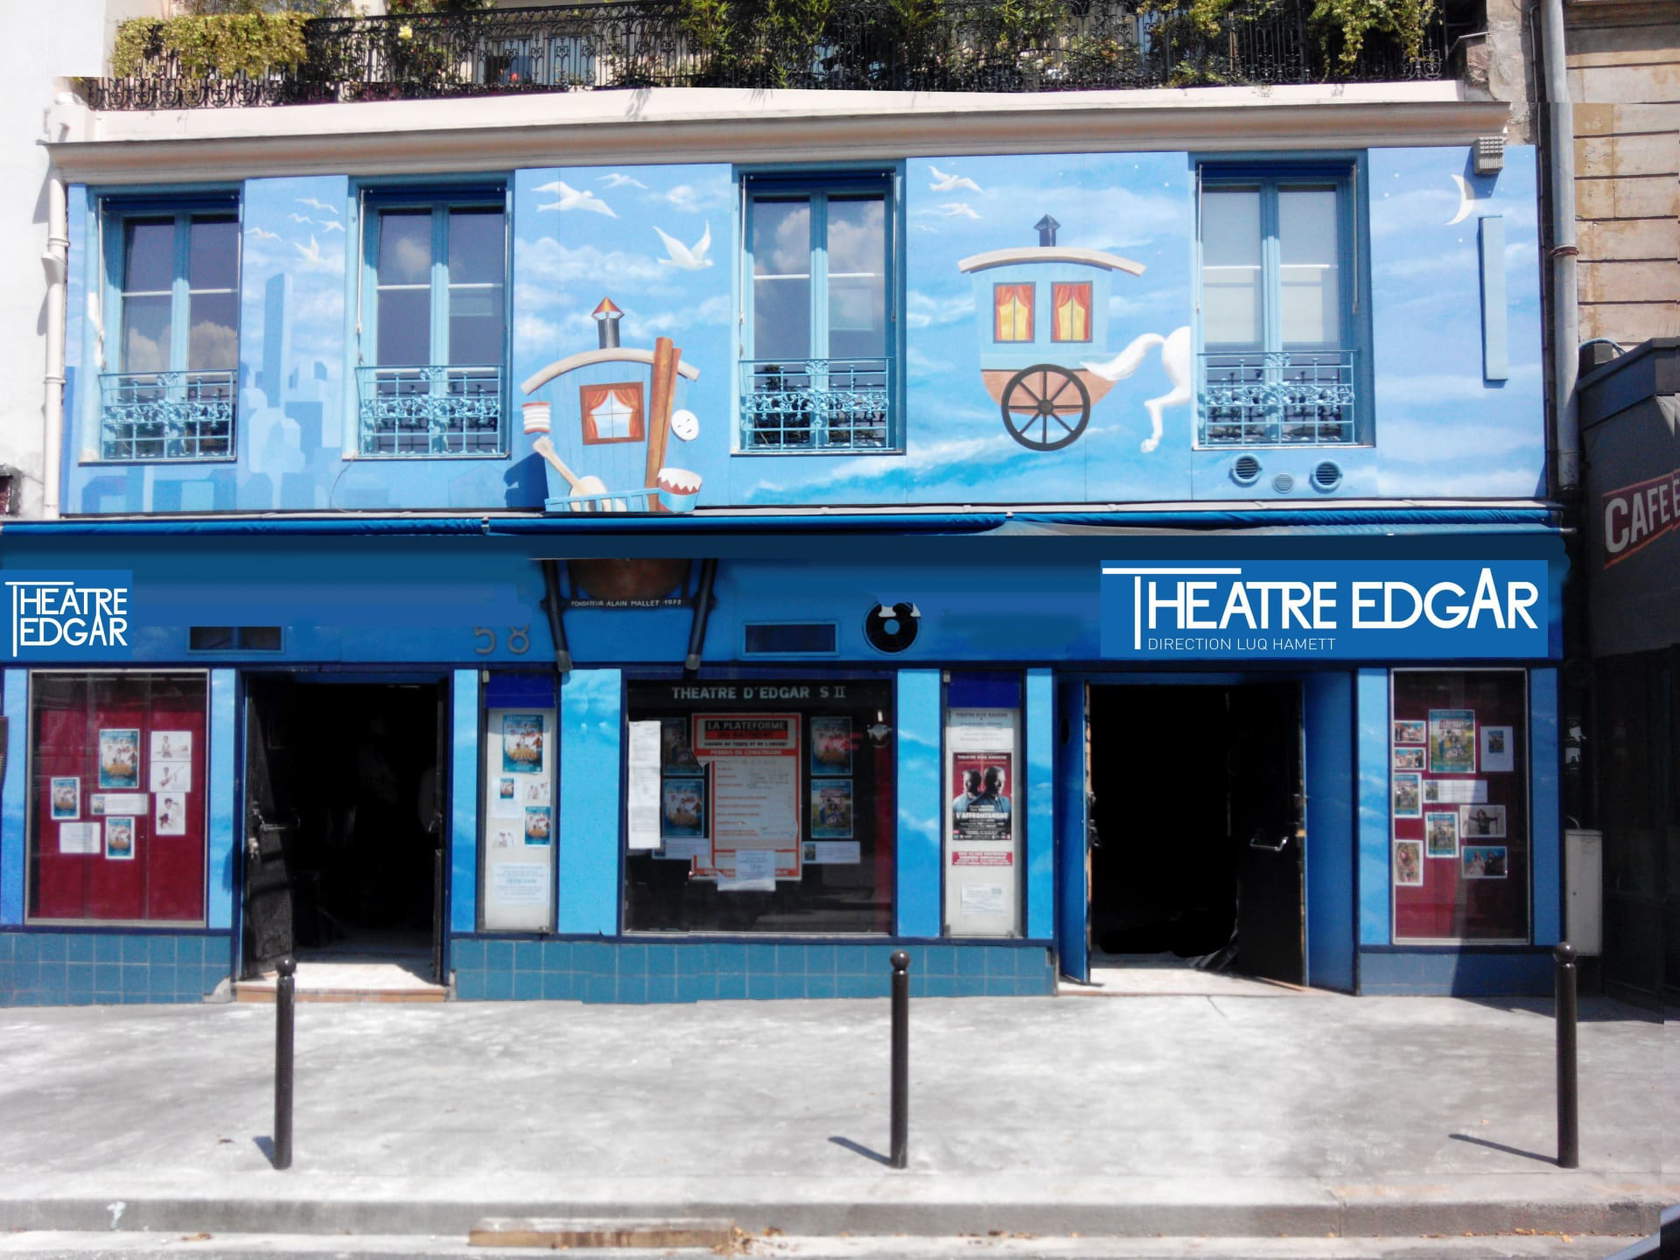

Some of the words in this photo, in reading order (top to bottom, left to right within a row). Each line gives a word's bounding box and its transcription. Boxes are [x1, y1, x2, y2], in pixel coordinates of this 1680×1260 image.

[1605, 485, 1671, 553] CAFE
[1102, 568, 1337, 650] THEATRE
[1352, 568, 1539, 629] EDGAR
[20, 615, 128, 646] EDGAR
[1148, 638, 1231, 650] DIRECTION
[1237, 638, 1268, 651] LUQ
[1273, 638, 1336, 650] HAMETT
[672, 687, 737, 699] THEATRE
[743, 686, 810, 699] D'EDGAR
